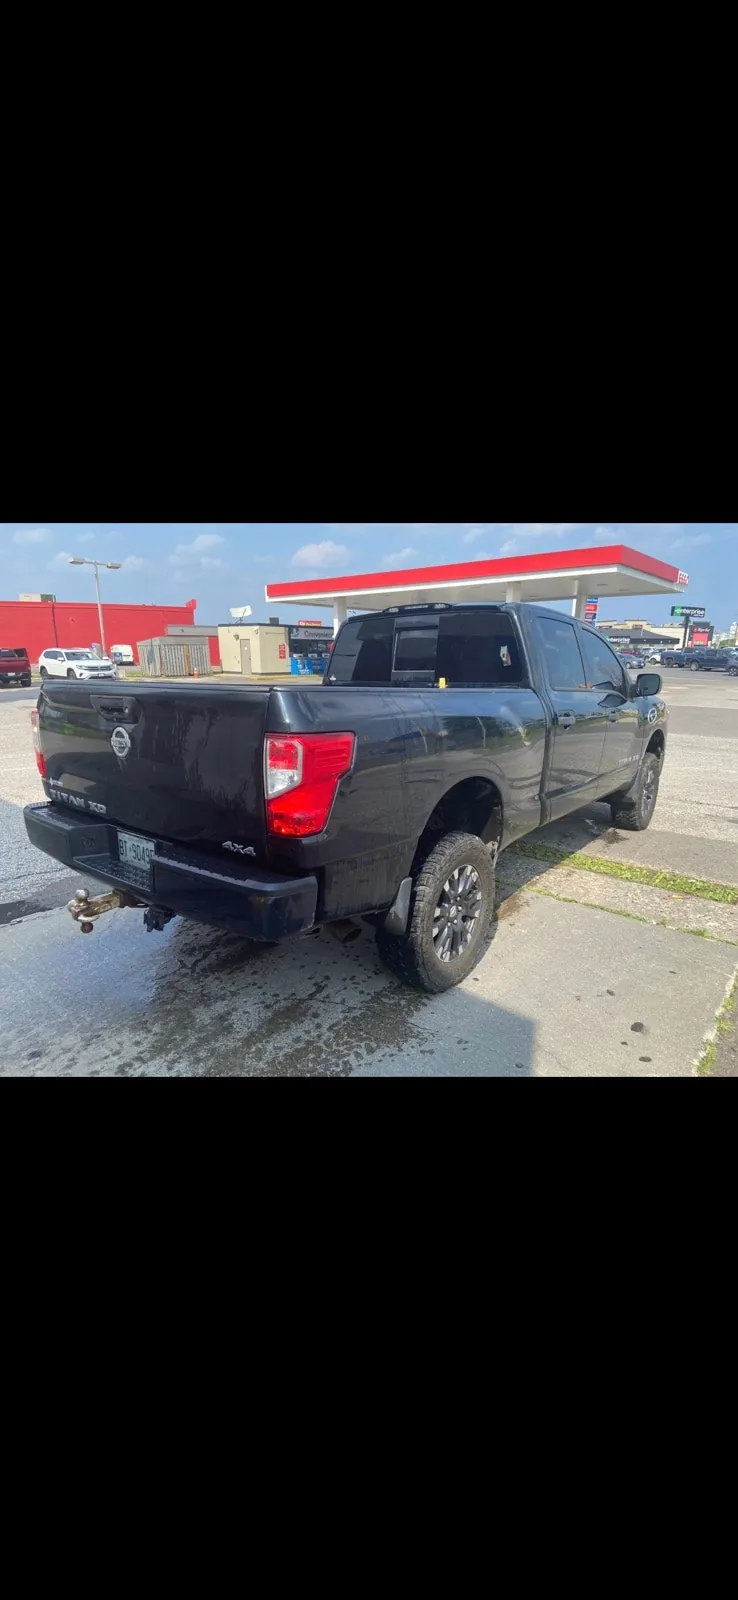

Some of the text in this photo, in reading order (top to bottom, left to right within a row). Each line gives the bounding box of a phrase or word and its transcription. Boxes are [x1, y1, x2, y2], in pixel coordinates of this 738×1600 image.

[50, 788, 107, 814] TITAN XD
[119, 839, 128, 857] BT
